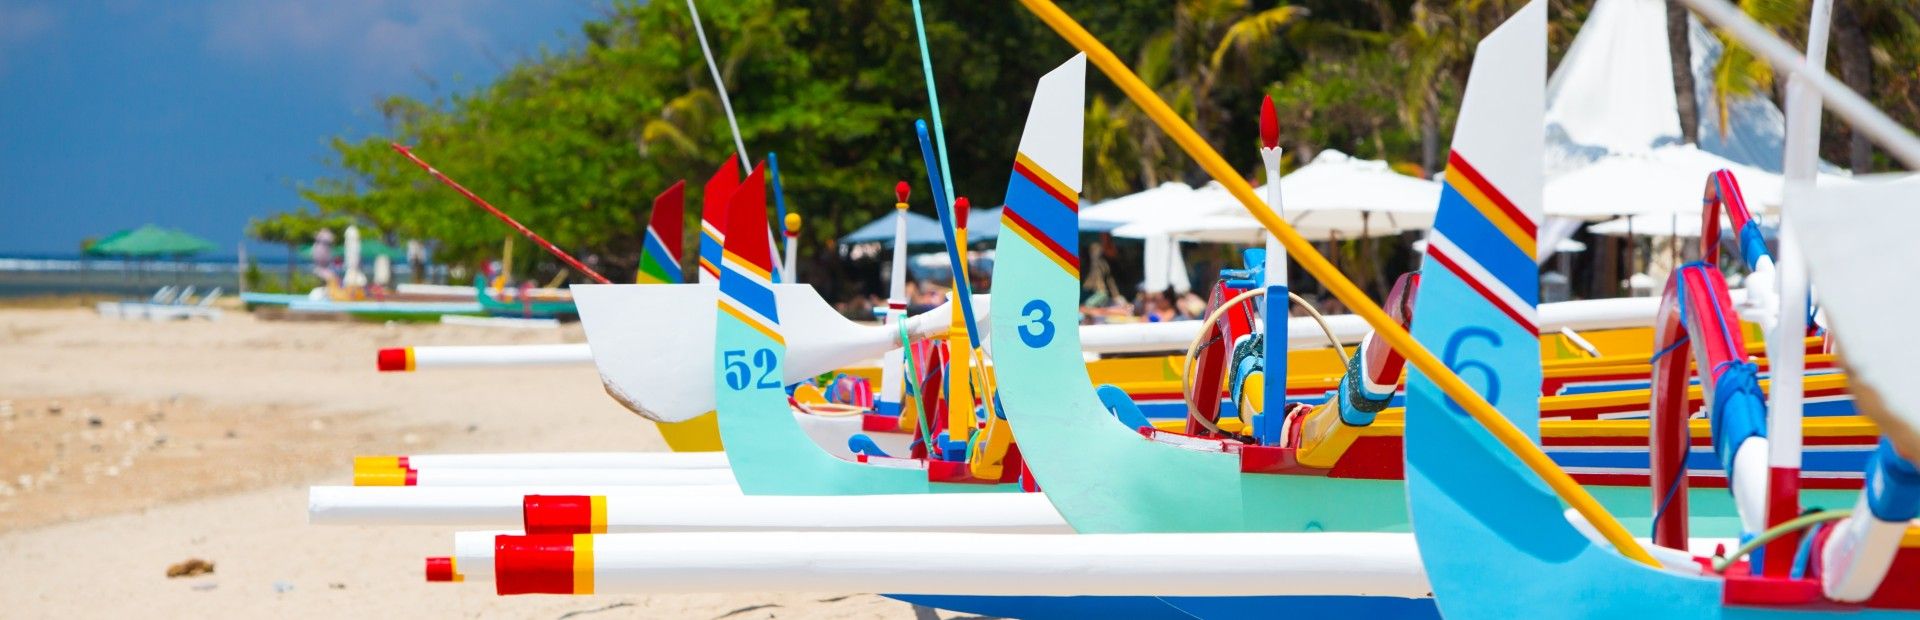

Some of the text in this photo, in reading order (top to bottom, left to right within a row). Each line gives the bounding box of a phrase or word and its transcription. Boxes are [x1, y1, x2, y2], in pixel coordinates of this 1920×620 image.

[1018, 299, 1055, 348] 3
[724, 348, 781, 390] 52
[1443, 327, 1502, 418] 6
